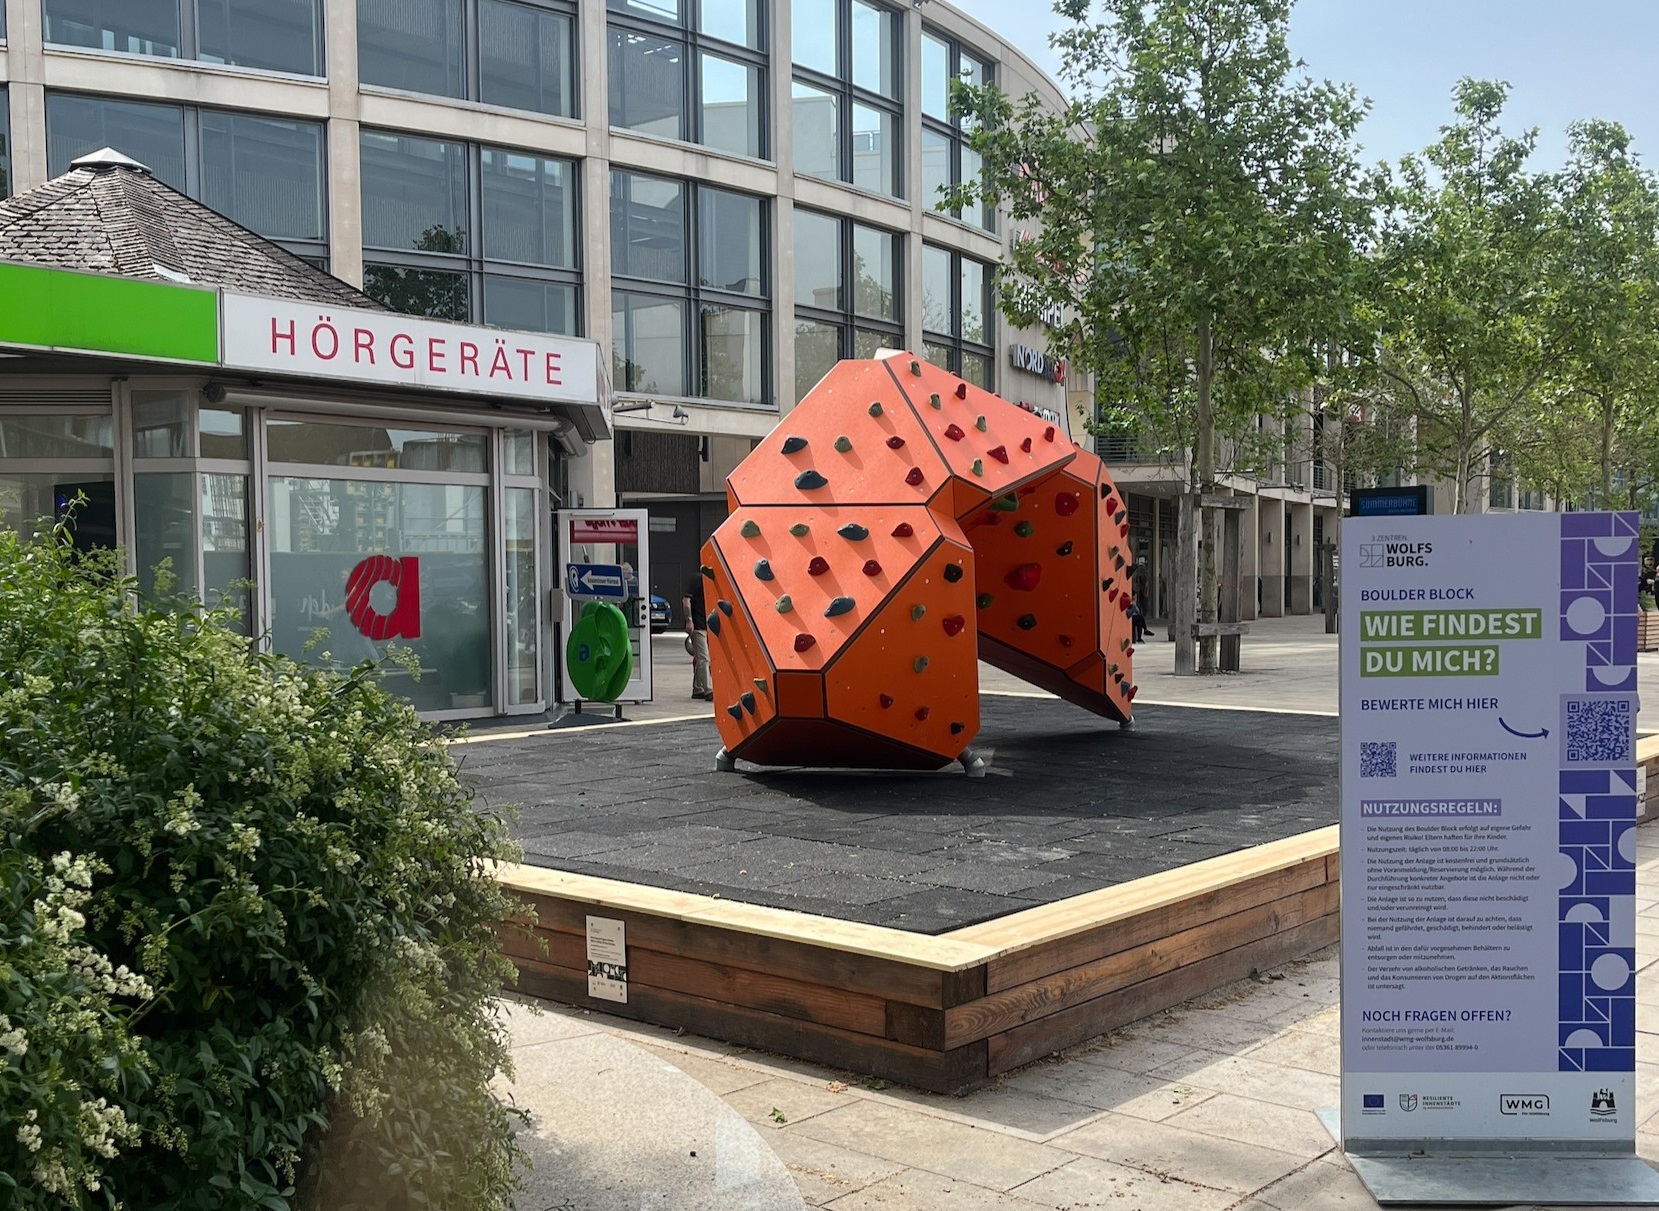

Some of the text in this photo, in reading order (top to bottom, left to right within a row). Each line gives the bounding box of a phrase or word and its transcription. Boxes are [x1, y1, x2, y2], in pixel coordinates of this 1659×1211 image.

[270, 315, 562, 386] HÖRGERÄTE
[1386, 542, 1432, 554] WOLFS
[1386, 555, 1429, 567] BURG.
[1361, 588, 1474, 601] BOULDER BLOCK
[1365, 613, 1537, 636] WIE FINDEST
[1366, 649, 1495, 672] DU MICH?
[1361, 697, 1498, 710] BEWERTE MICH HIER
[1409, 752, 1527, 761] WEITERE INFORMATIONEN
[1409, 765, 1447, 773] FINDEST
[1363, 801, 1498, 814] NUTZUNGSREGELN:
[1367, 875, 1408, 883] Durchführung
[1362, 1010, 1512, 1021] NOCH FRAGEN OFFEN?
[1506, 1100, 1543, 1109] WMG
